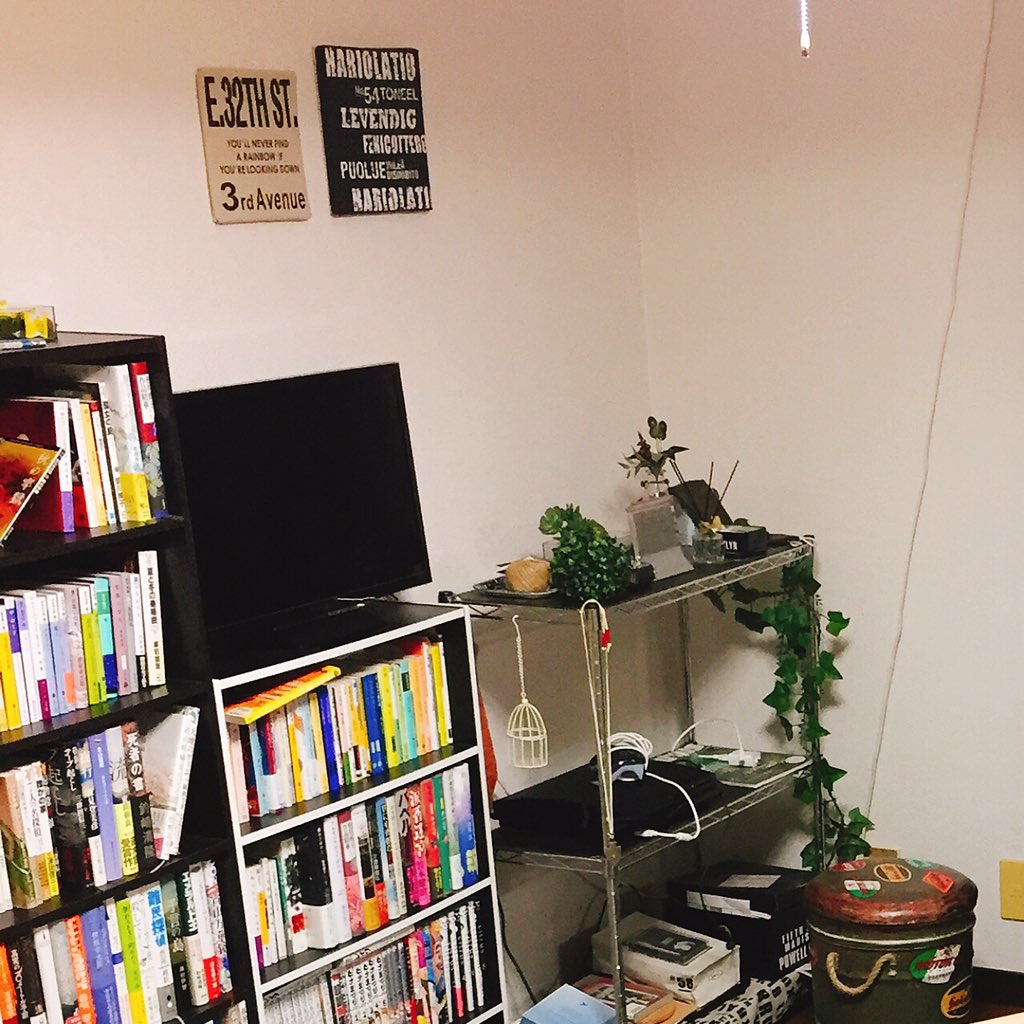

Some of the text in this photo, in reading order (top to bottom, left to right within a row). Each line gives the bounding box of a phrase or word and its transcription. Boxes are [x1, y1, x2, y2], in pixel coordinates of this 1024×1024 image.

[236, 152, 241, 161] A
[243, 152, 275, 161] RAINBOW
[247, 165, 279, 174] LOOKING
[220, 181, 306, 211] 3rd Avenue
[778, 946, 808, 971] POWELL
